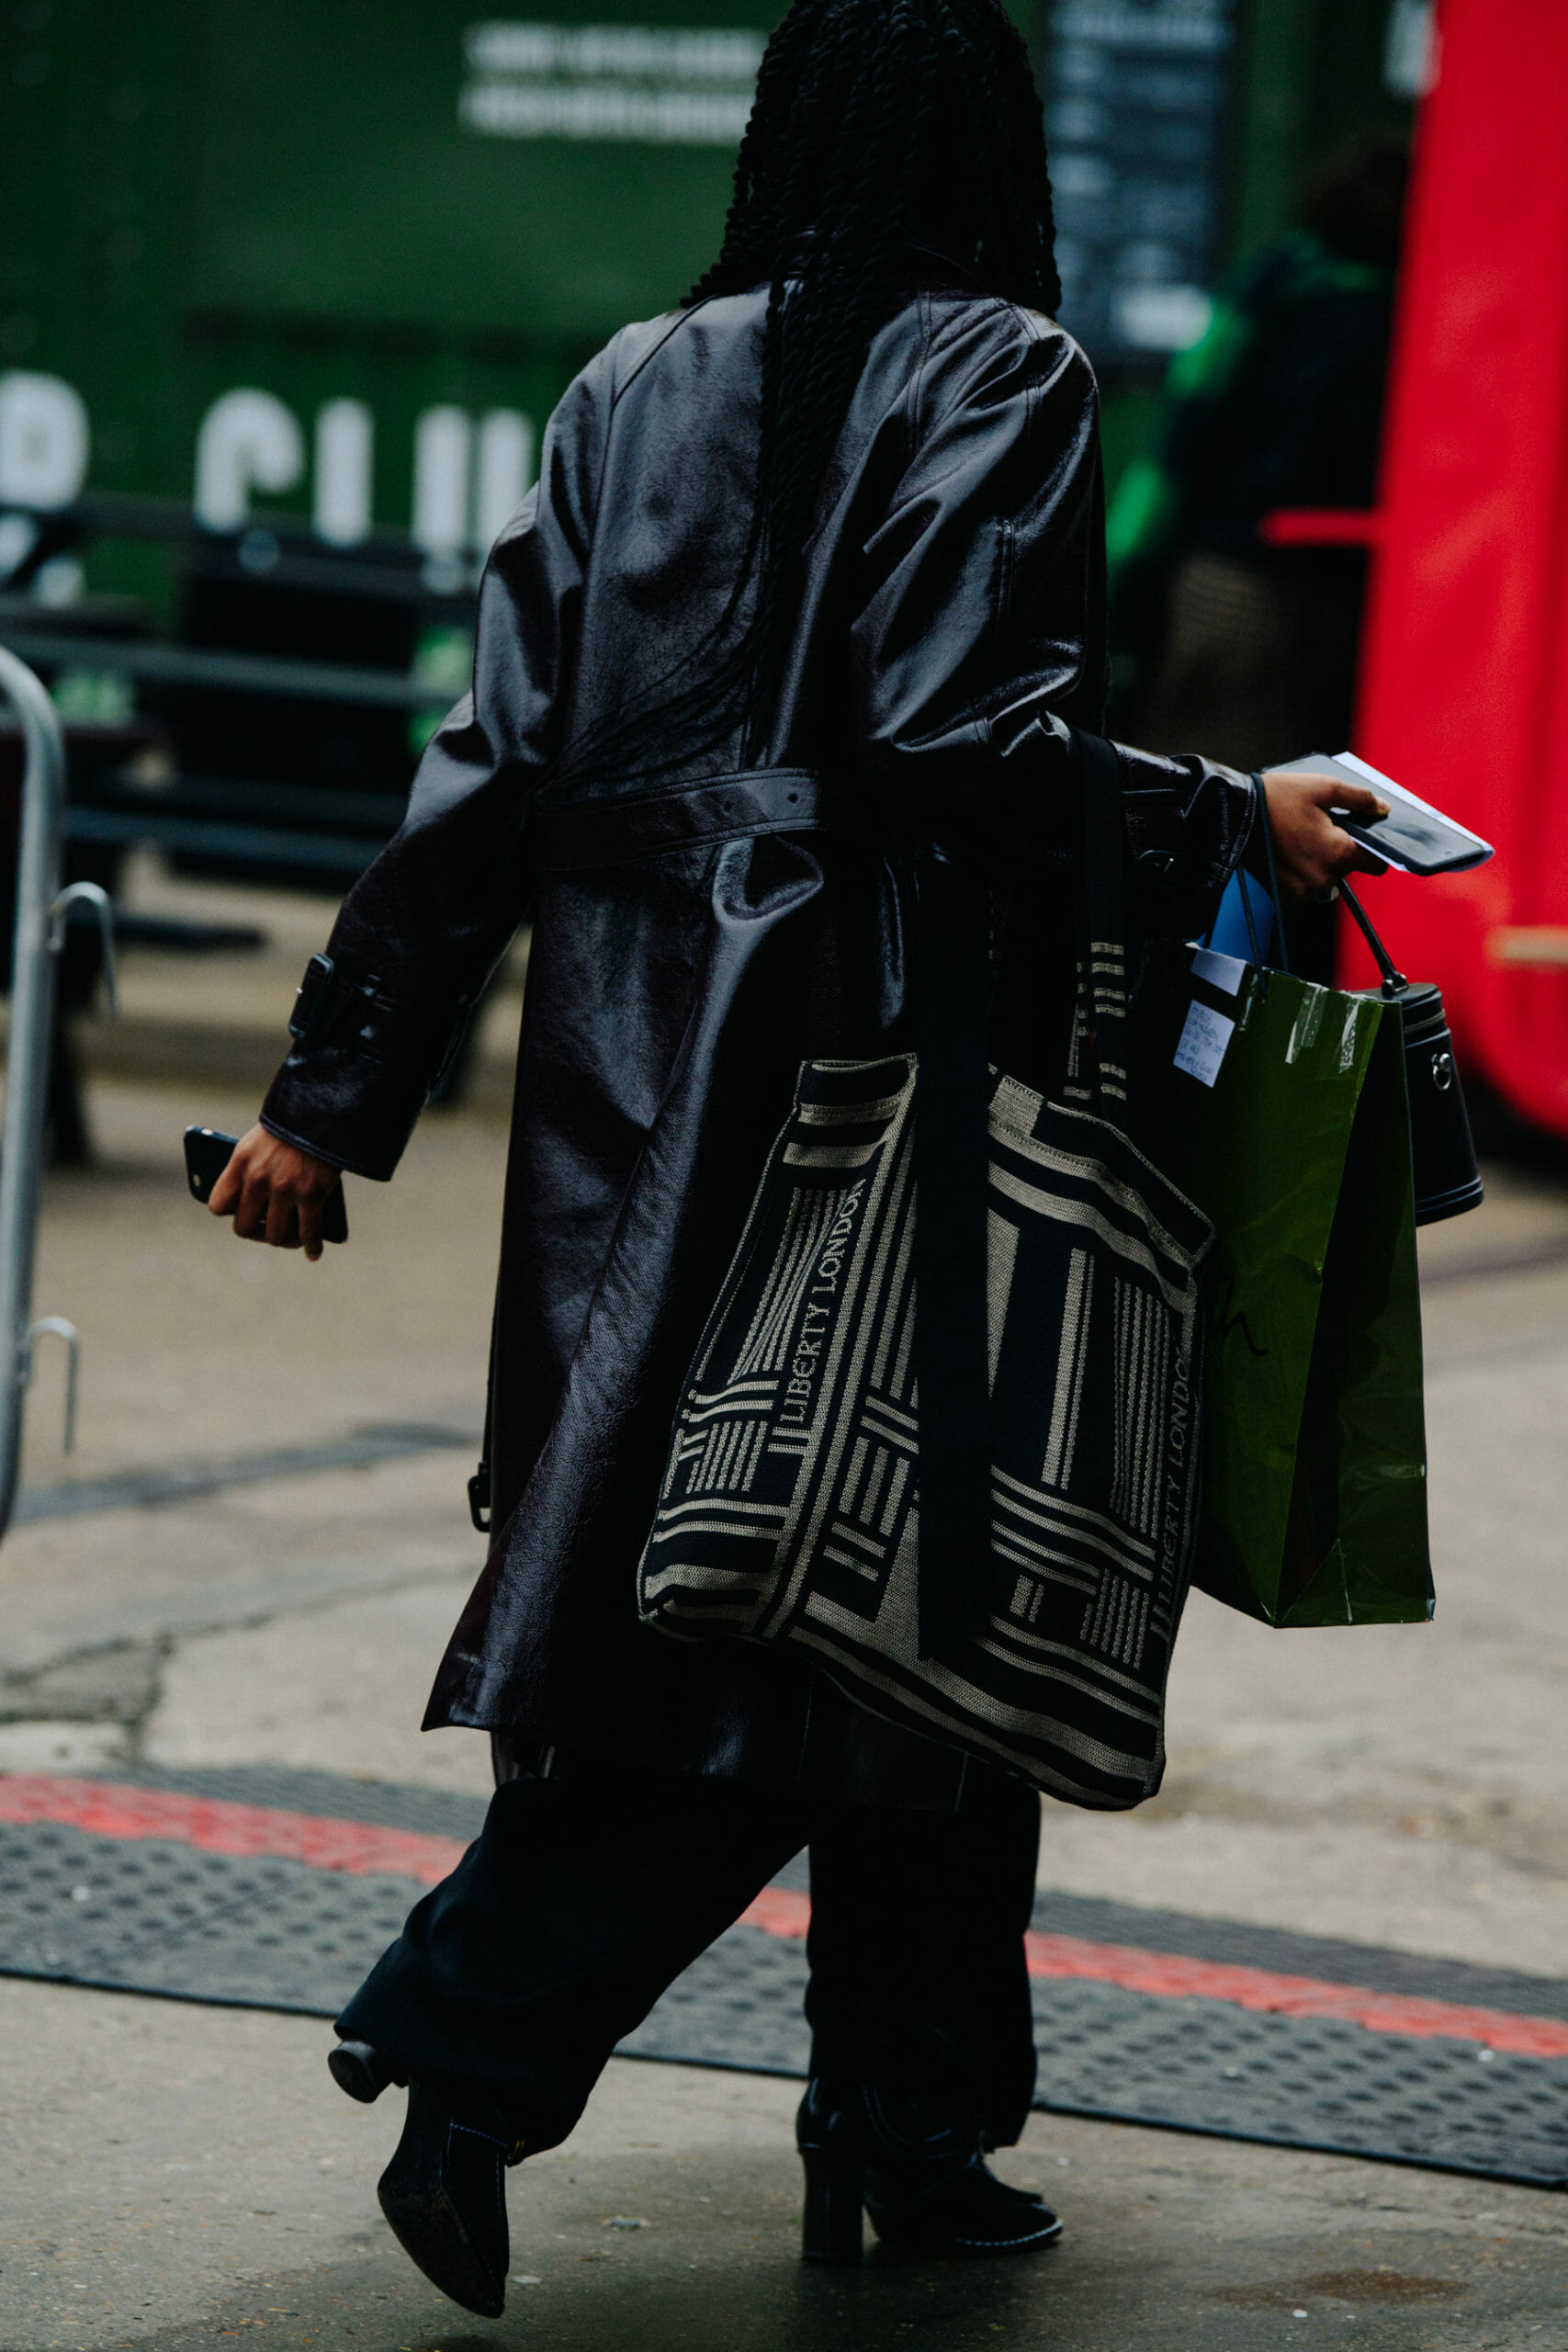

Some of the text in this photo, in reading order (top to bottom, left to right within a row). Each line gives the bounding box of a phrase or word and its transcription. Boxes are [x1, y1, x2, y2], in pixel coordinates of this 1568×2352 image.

[778, 1301, 831, 1423] LIBERTY
[1157, 1348, 1191, 1605] LIBERTY LONDO
